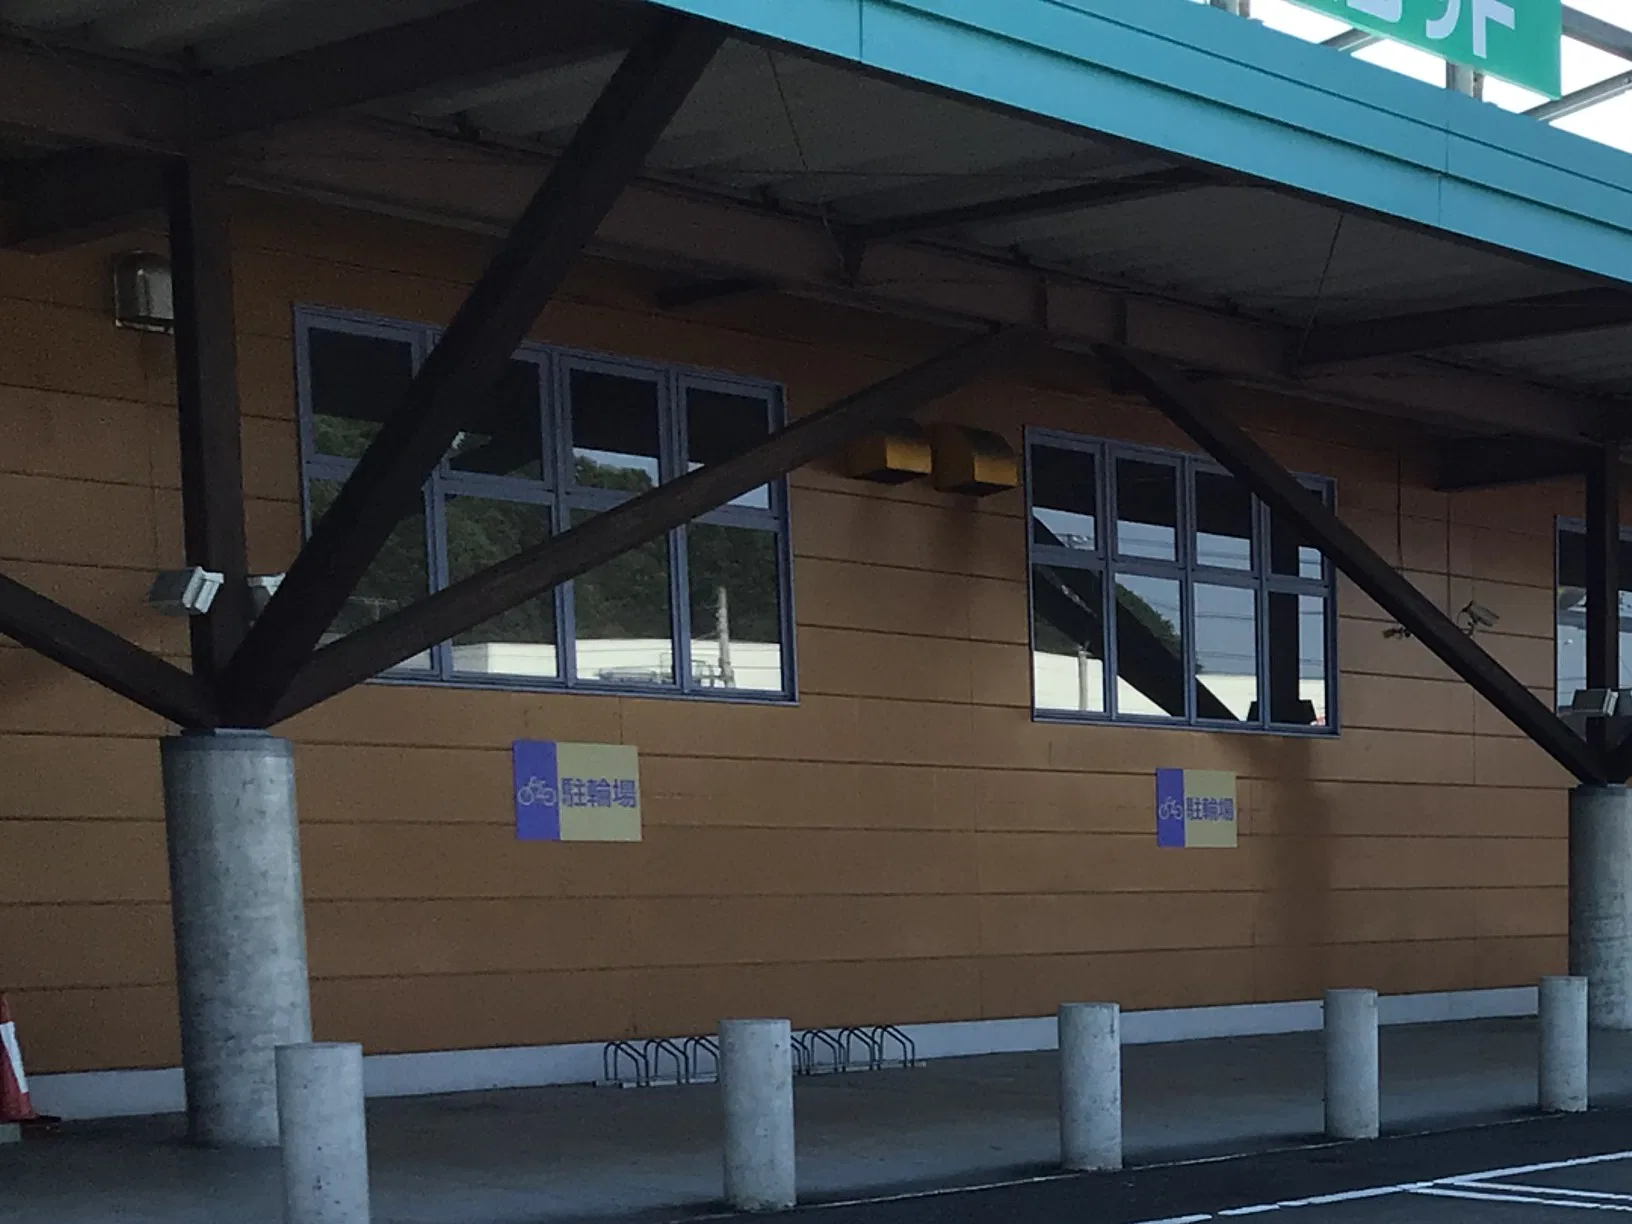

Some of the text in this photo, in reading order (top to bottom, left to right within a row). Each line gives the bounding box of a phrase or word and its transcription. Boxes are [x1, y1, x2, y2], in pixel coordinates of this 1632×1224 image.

[561, 777, 636, 808] 駐輪場
[1186, 797, 1233, 821] 駐輪場
